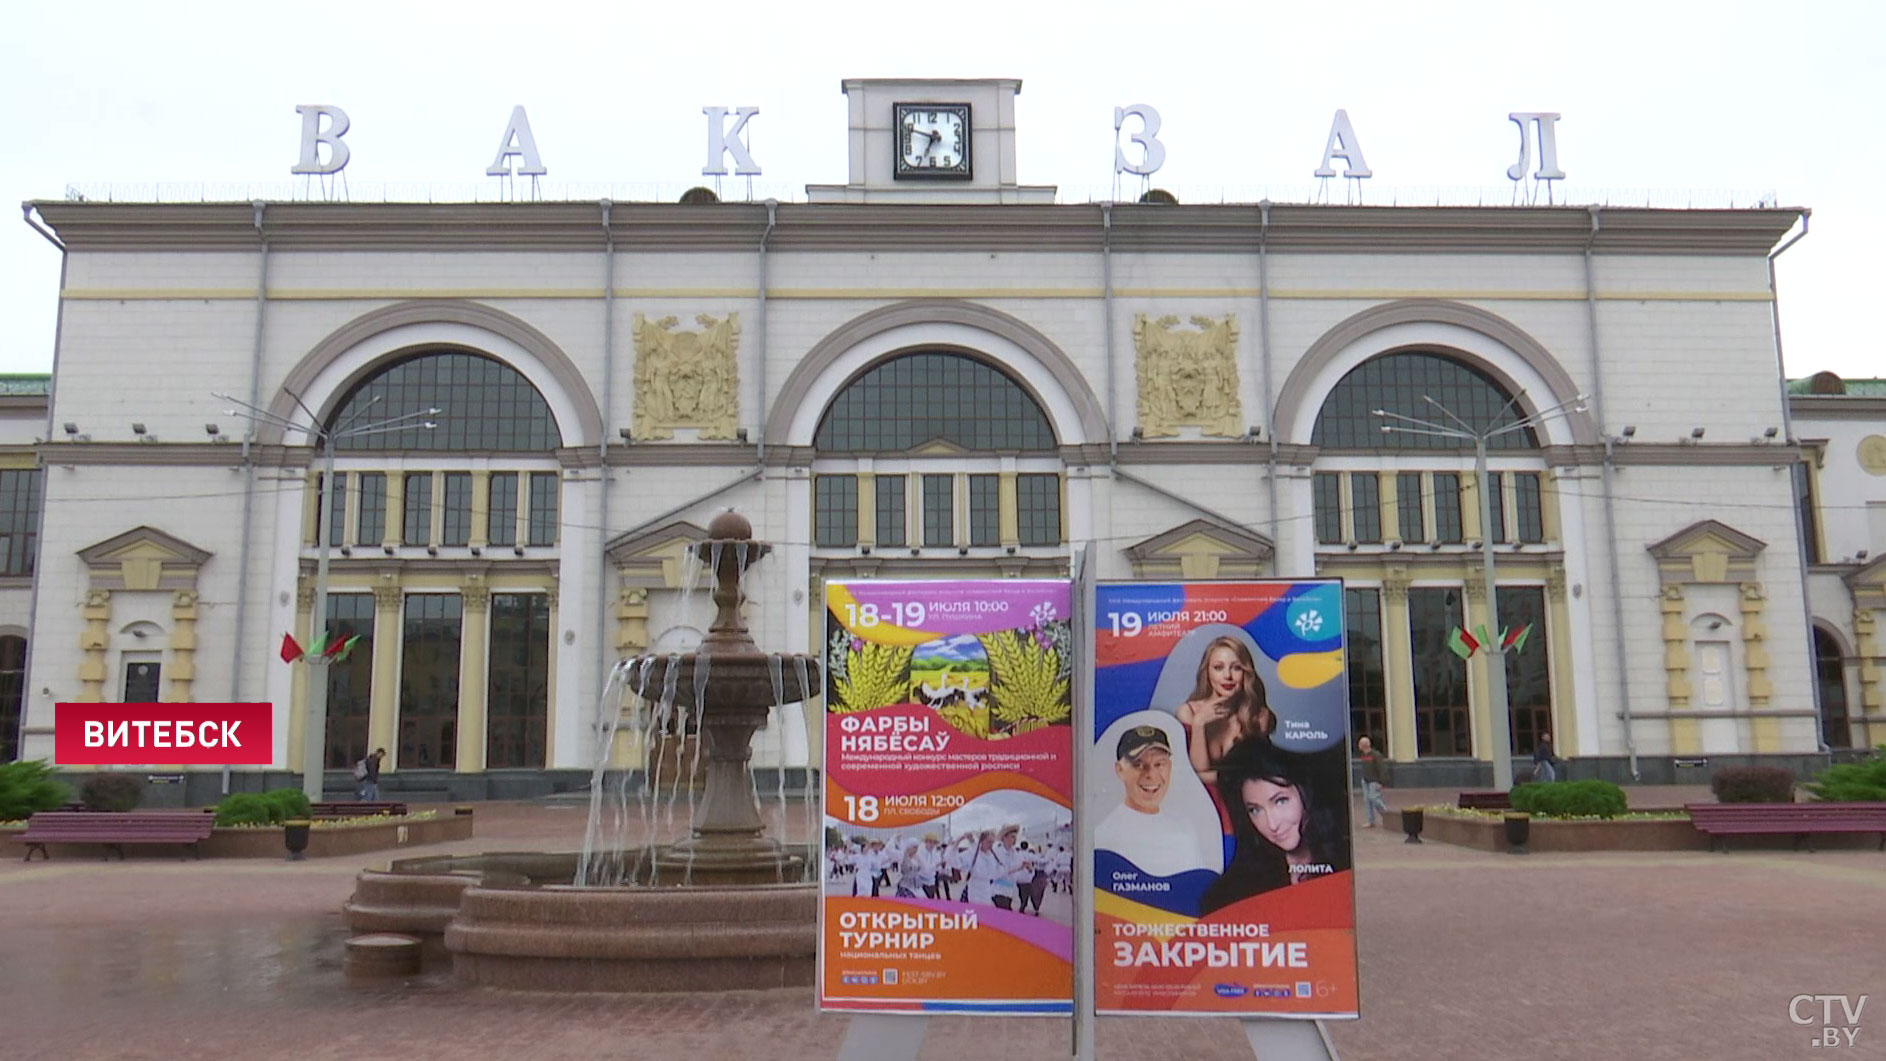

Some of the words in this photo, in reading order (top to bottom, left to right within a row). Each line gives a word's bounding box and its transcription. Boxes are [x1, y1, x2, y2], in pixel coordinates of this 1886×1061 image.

[927, 112, 937, 124] 12
[915, 156, 923, 168] 7
[929, 156, 937, 168] 6
[943, 156, 951, 168] 5
[929, 601, 971, 612] ИЮЛЯ
[974, 600, 1009, 612] 10:00
[845, 601, 926, 628] 18-19
[1147, 611, 1190, 622] ИЮЛЯ
[1193, 610, 1227, 622] 21:00
[1107, 611, 1143, 637] 19
[841, 716, 930, 733] ФАРБЫ
[1285, 720, 1310, 729] Тина
[841, 731, 951, 752] НЯБЁСАЎ
[1285, 731, 1328, 740] КАРОЛЬ
[841, 753, 913, 761] Международный
[948, 753, 988, 761] мастеров
[988, 752, 1050, 761] традиционной
[841, 762, 902, 770] современной
[904, 762, 979, 770] художественной
[884, 795, 927, 807] ИЮЛЯ
[931, 794, 965, 807] 12:00
[844, 795, 879, 821] 18
[898, 808, 940, 816] СВОБОДЫ
[1288, 864, 1334, 874] ЛОЛИТА
[1112, 872, 1138, 881] Олег
[1112, 882, 1170, 892] ГАЗМАНОВ
[839, 909, 979, 930] ОТКРЫТЫЙ
[1113, 923, 1270, 937] ТОРЖЕСТВЕННОЕ
[839, 932, 935, 949] ТУРНИР
[840, 952, 907, 960] национальных
[909, 952, 942, 960] танцев
[1113, 942, 1308, 968] ЗАКРЫТИЕ
[1316, 980, 1338, 997] 6+
